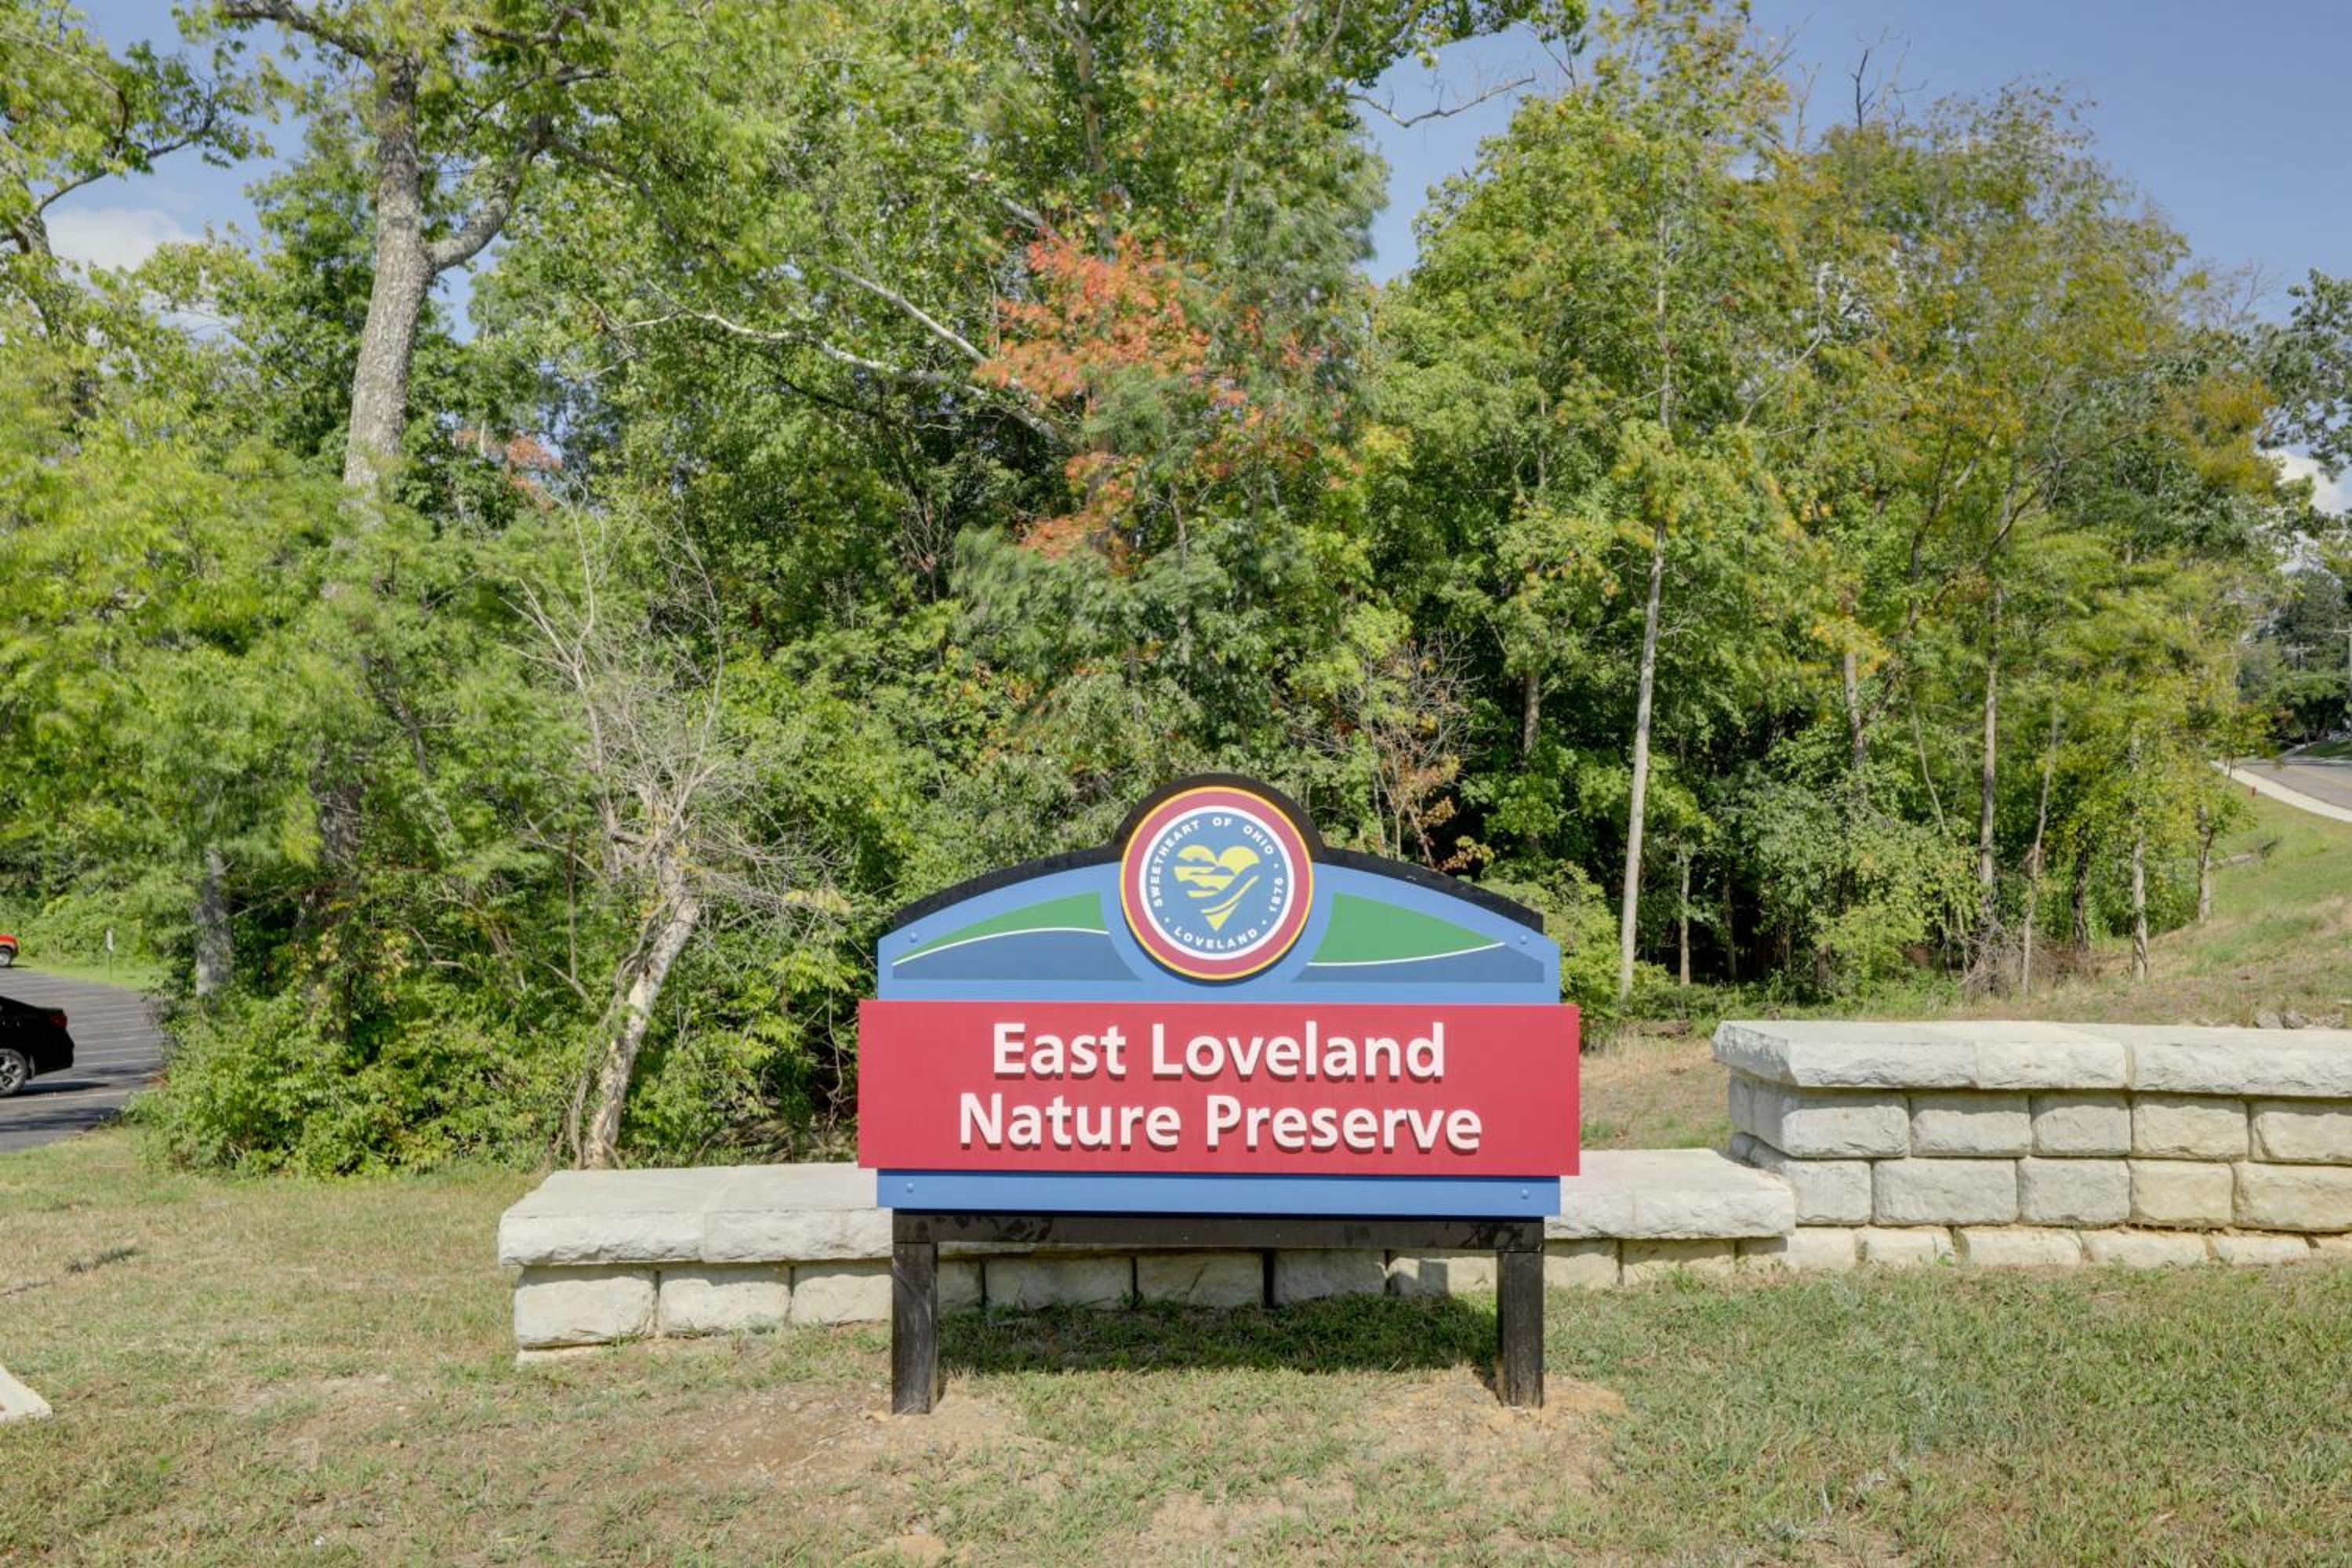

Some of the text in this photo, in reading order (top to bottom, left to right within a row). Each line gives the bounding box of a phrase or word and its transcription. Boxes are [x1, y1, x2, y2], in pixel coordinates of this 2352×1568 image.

[1150, 816, 1274, 907] SWEETHEART OF OHIO
[1174, 927, 1258, 949] LOVELAND
[993, 1020, 1446, 1079] East Loveland
[960, 1092, 1483, 1151] Nature Preserve
